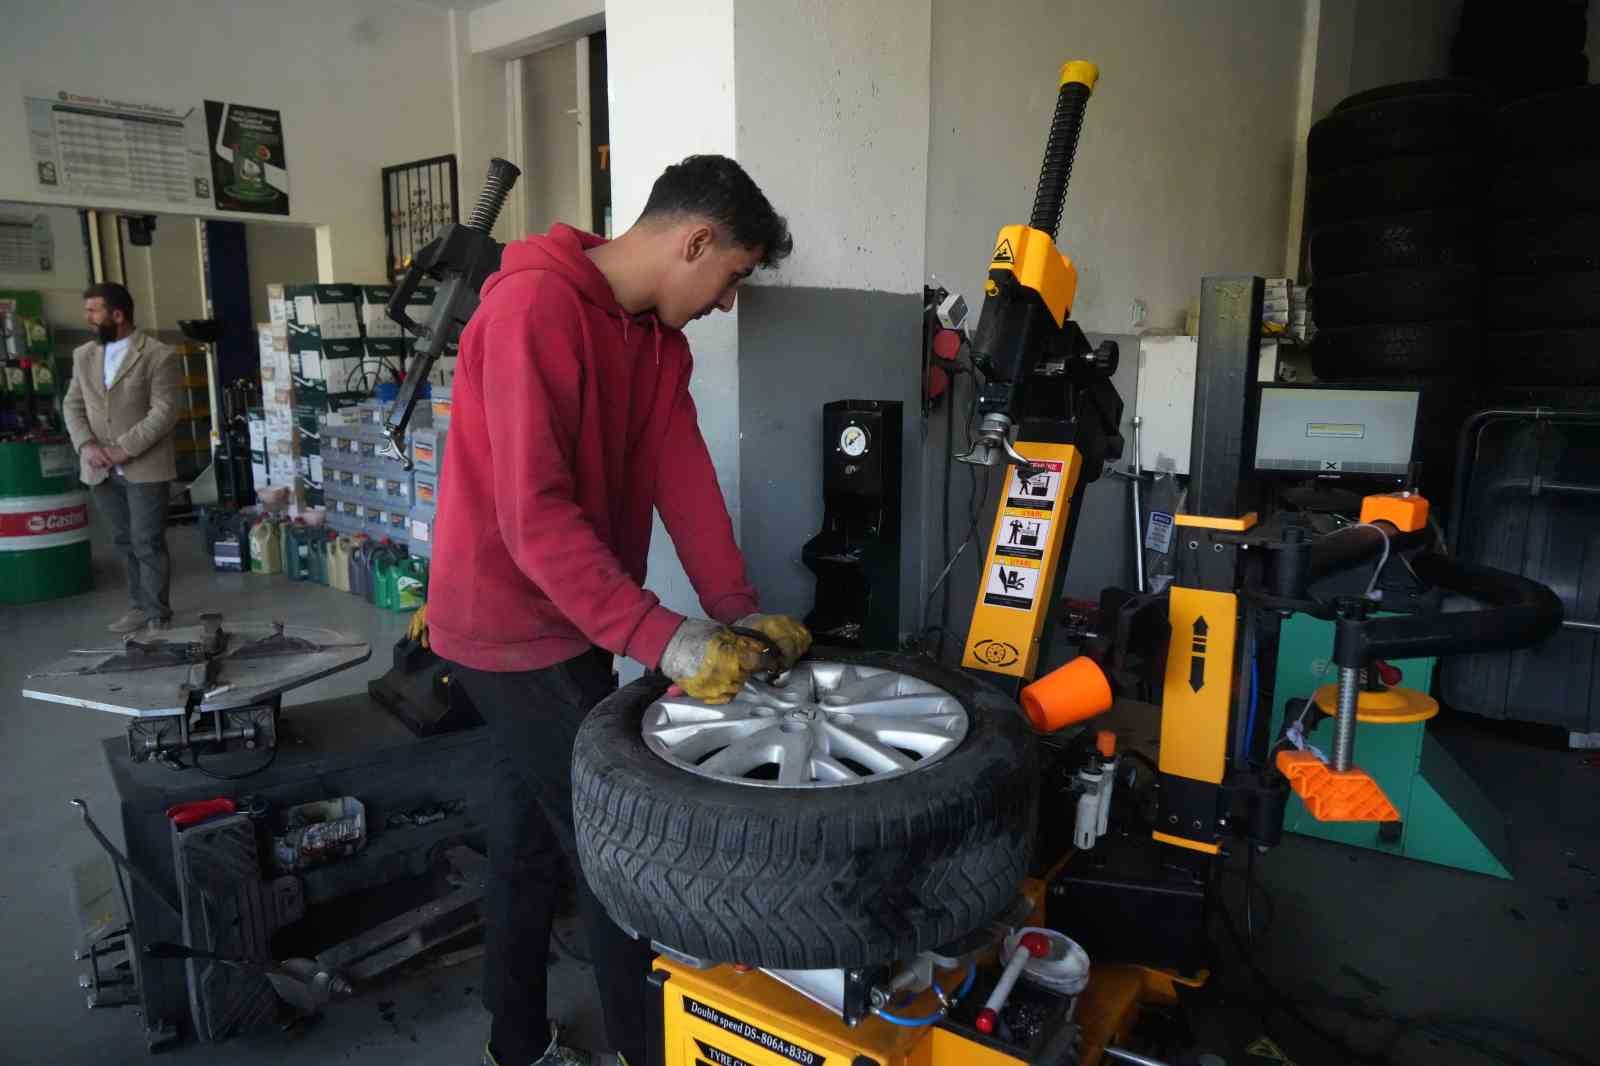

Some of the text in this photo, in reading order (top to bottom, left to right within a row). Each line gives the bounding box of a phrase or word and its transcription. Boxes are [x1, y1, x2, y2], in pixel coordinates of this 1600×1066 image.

[46, 512, 84, 529] Cast
[691, 1001, 718, 1023] Double
[719, 1016, 743, 1033] speed
[709, 1048, 733, 1066] TYRE
